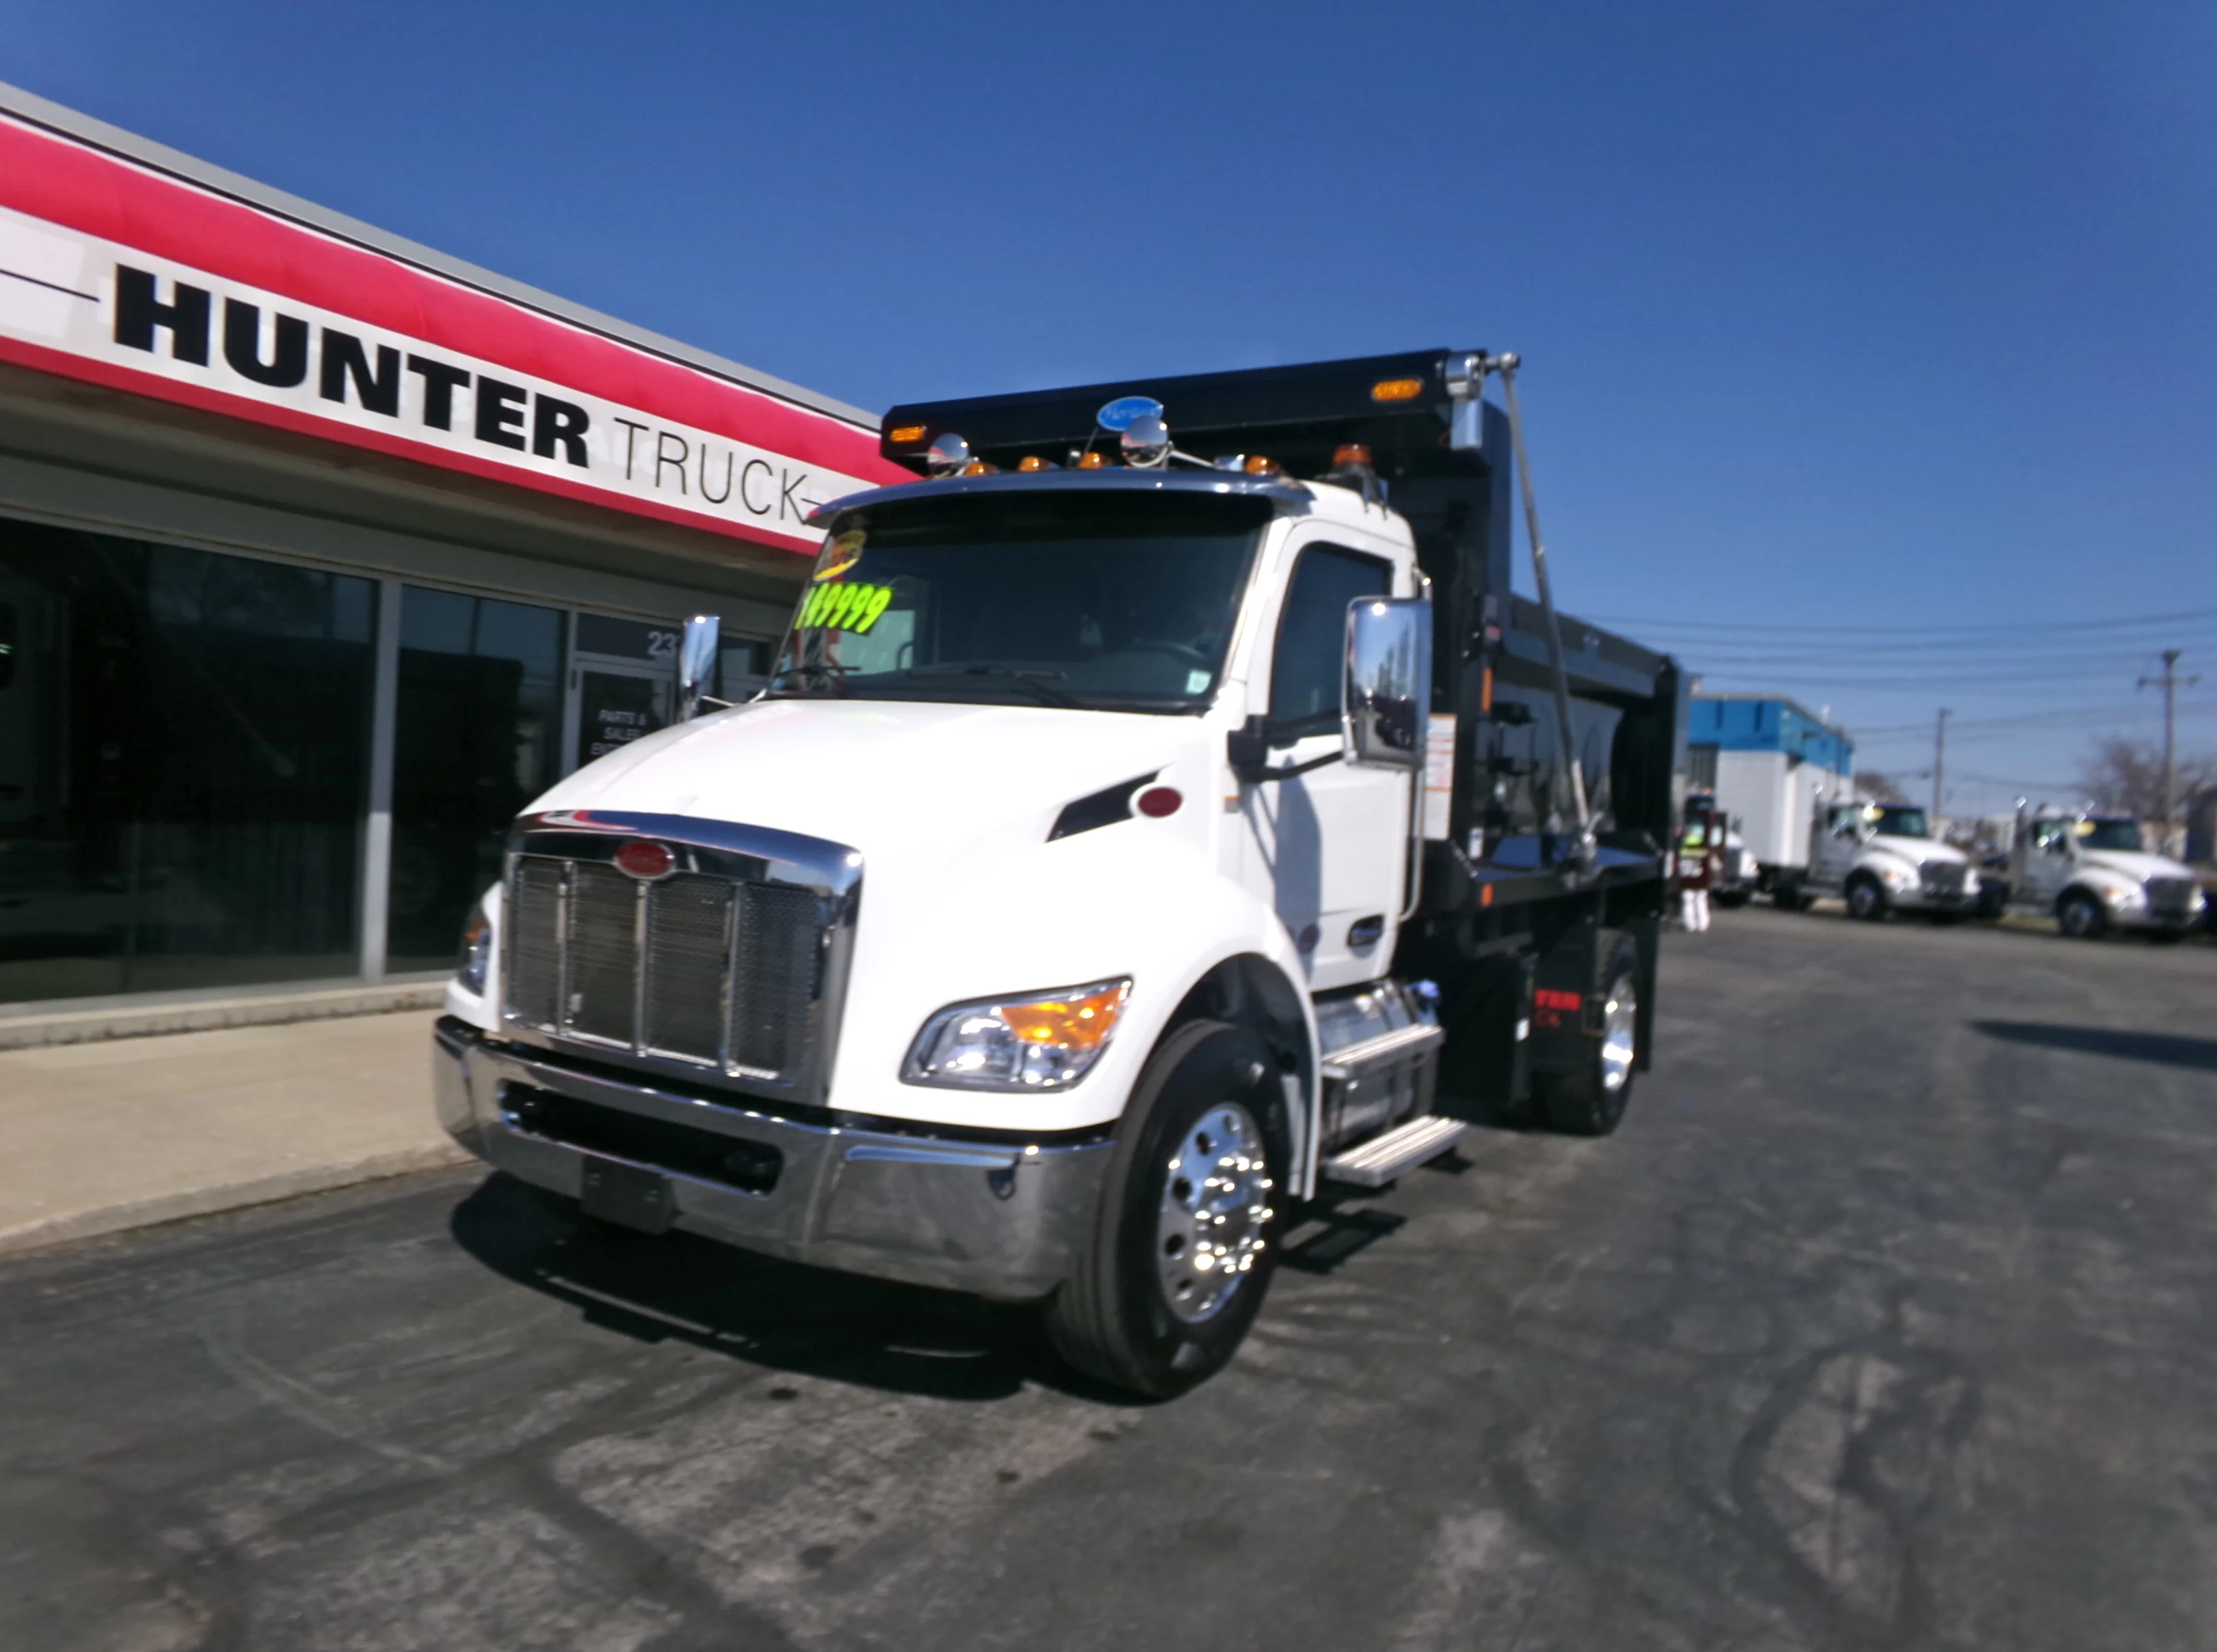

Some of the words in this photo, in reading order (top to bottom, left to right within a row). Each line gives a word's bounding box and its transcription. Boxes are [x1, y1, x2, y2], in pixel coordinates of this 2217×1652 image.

[115, 263, 590, 469] HUNTER
[613, 416, 808, 525] TRUCK
[648, 631, 680, 657] 23
